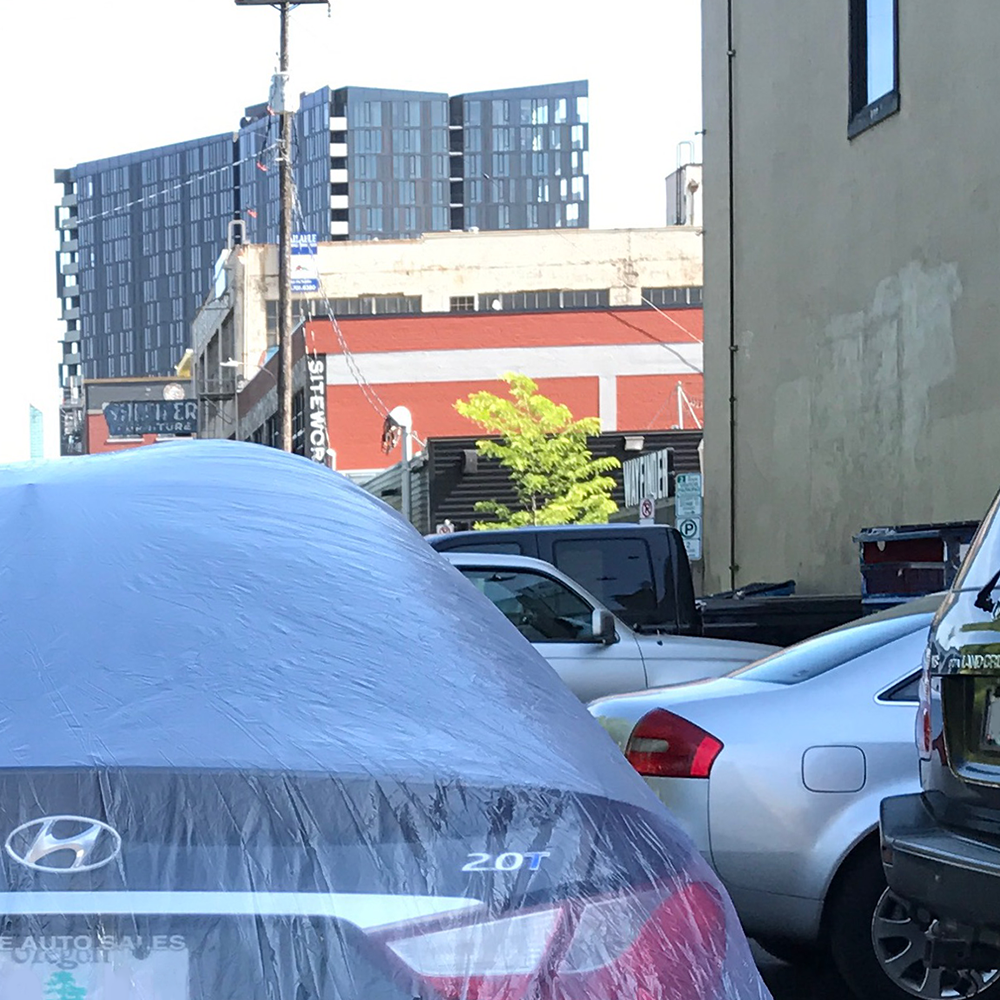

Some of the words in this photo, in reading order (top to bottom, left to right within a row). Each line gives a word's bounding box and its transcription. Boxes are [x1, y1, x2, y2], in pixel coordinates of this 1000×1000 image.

[685, 523, 694, 534] P
[21, 935, 92, 951] AUTO
[100, 935, 187, 951] SALES
